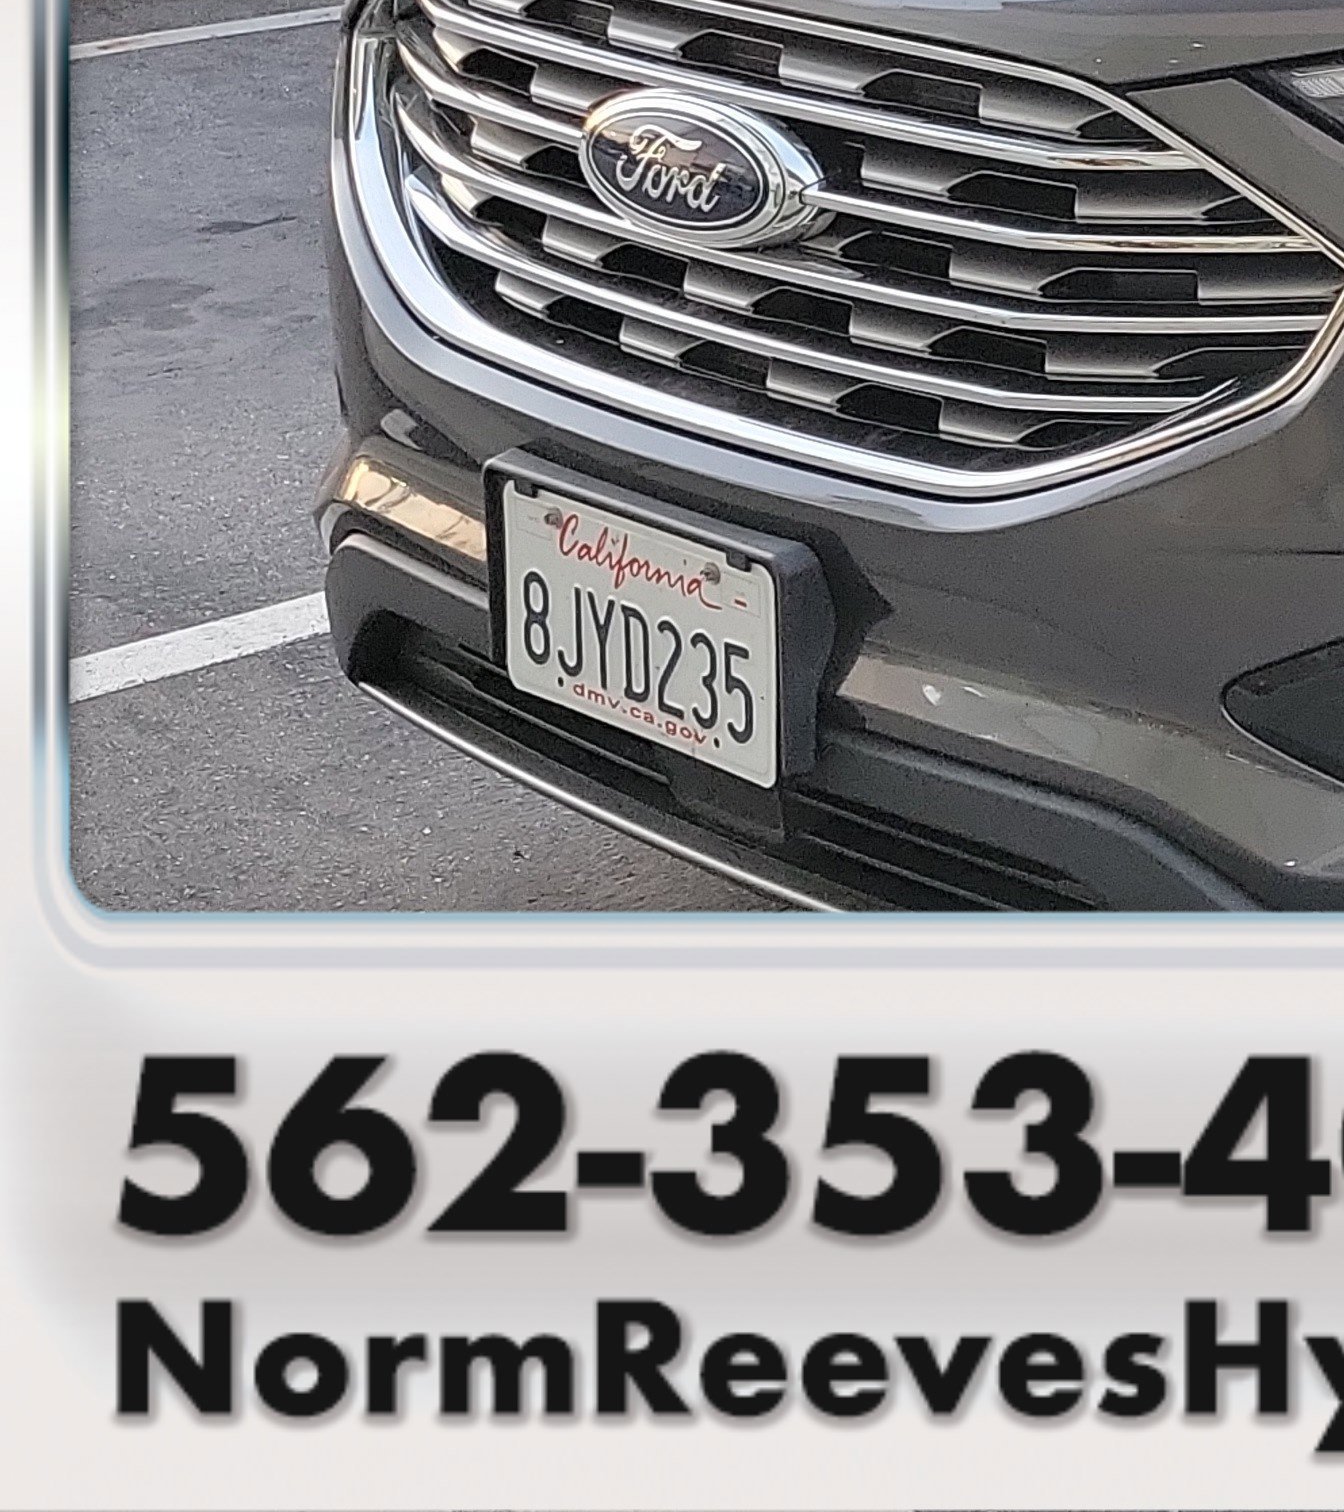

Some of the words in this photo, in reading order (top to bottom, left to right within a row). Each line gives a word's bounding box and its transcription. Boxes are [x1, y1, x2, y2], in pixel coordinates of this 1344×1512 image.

[615, 123, 727, 213] Ford
[557, 514, 722, 610] California
[523, 571, 755, 744] 8JYD235
[573, 682, 709, 746] dmv.ca.gov
